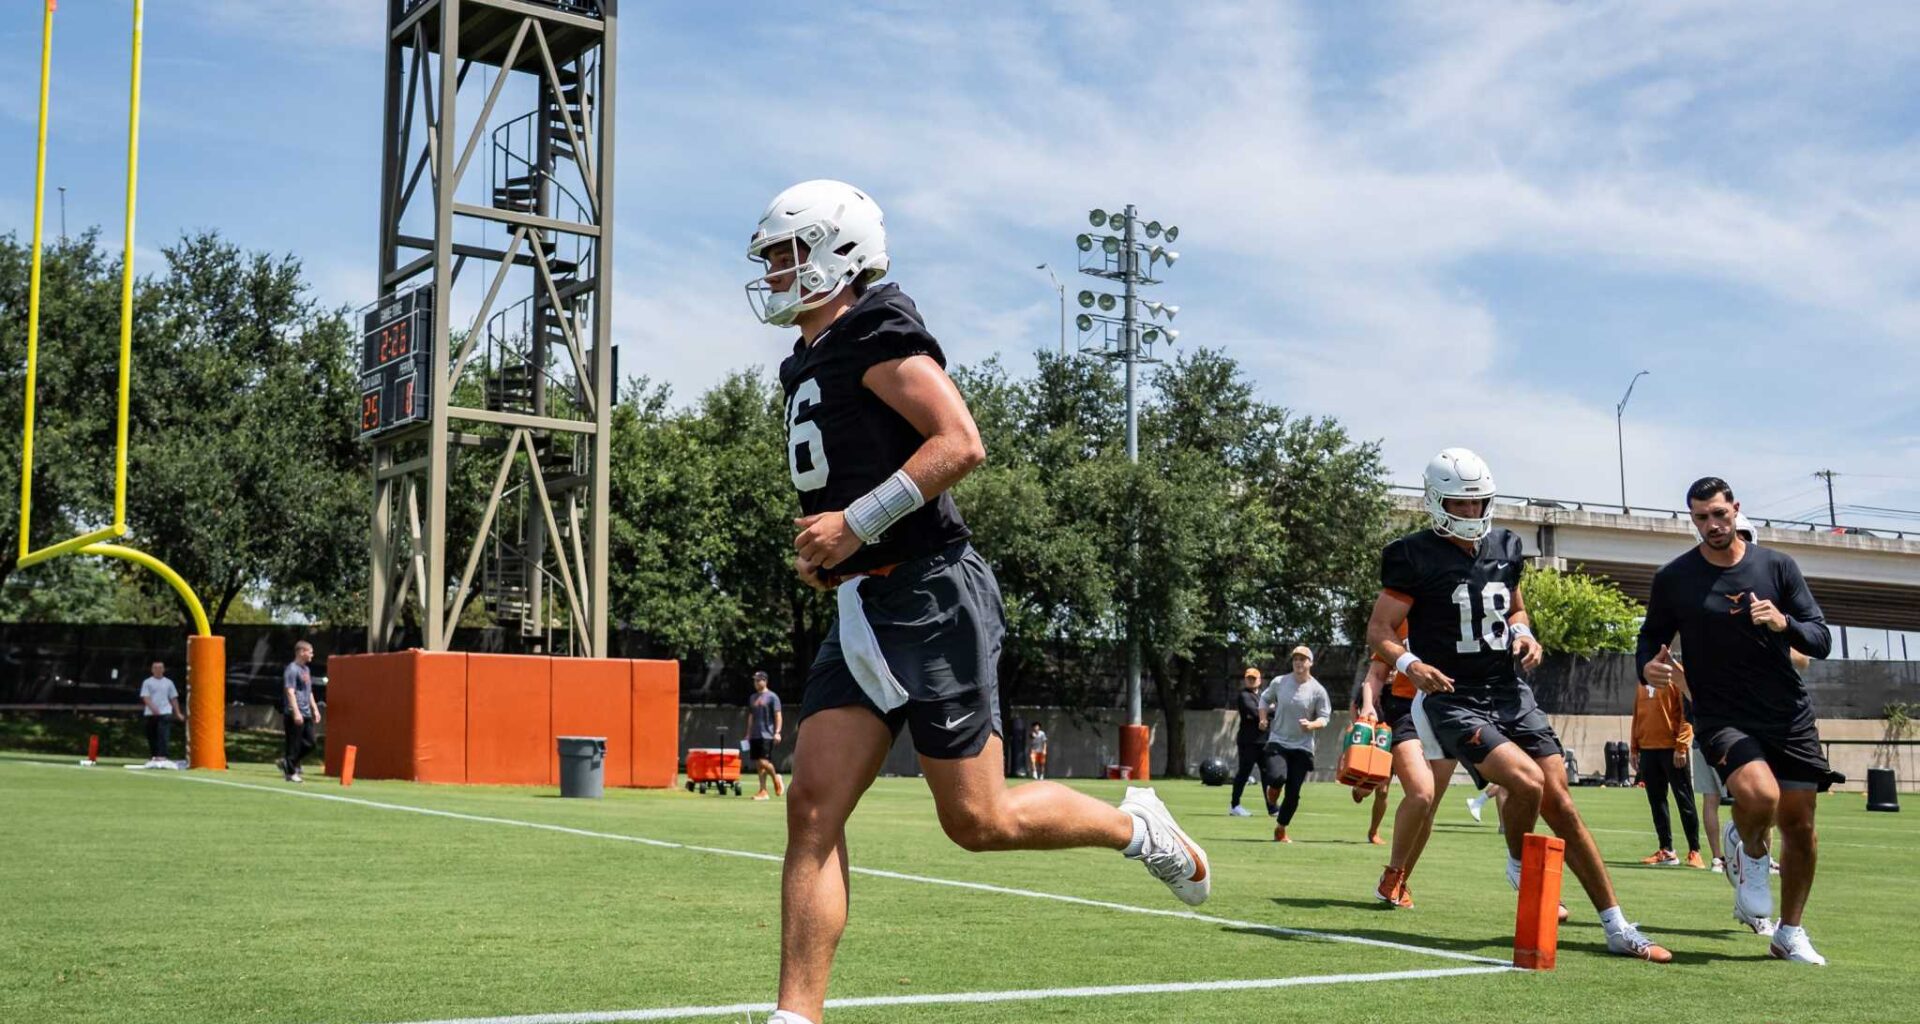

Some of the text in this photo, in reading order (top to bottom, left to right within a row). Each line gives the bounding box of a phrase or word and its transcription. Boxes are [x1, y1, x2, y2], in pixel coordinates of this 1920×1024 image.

[784, 377, 830, 492] 6
[1452, 582, 1511, 653] 18
[1352, 731, 1362, 744] G
[1376, 734, 1387, 746] G
